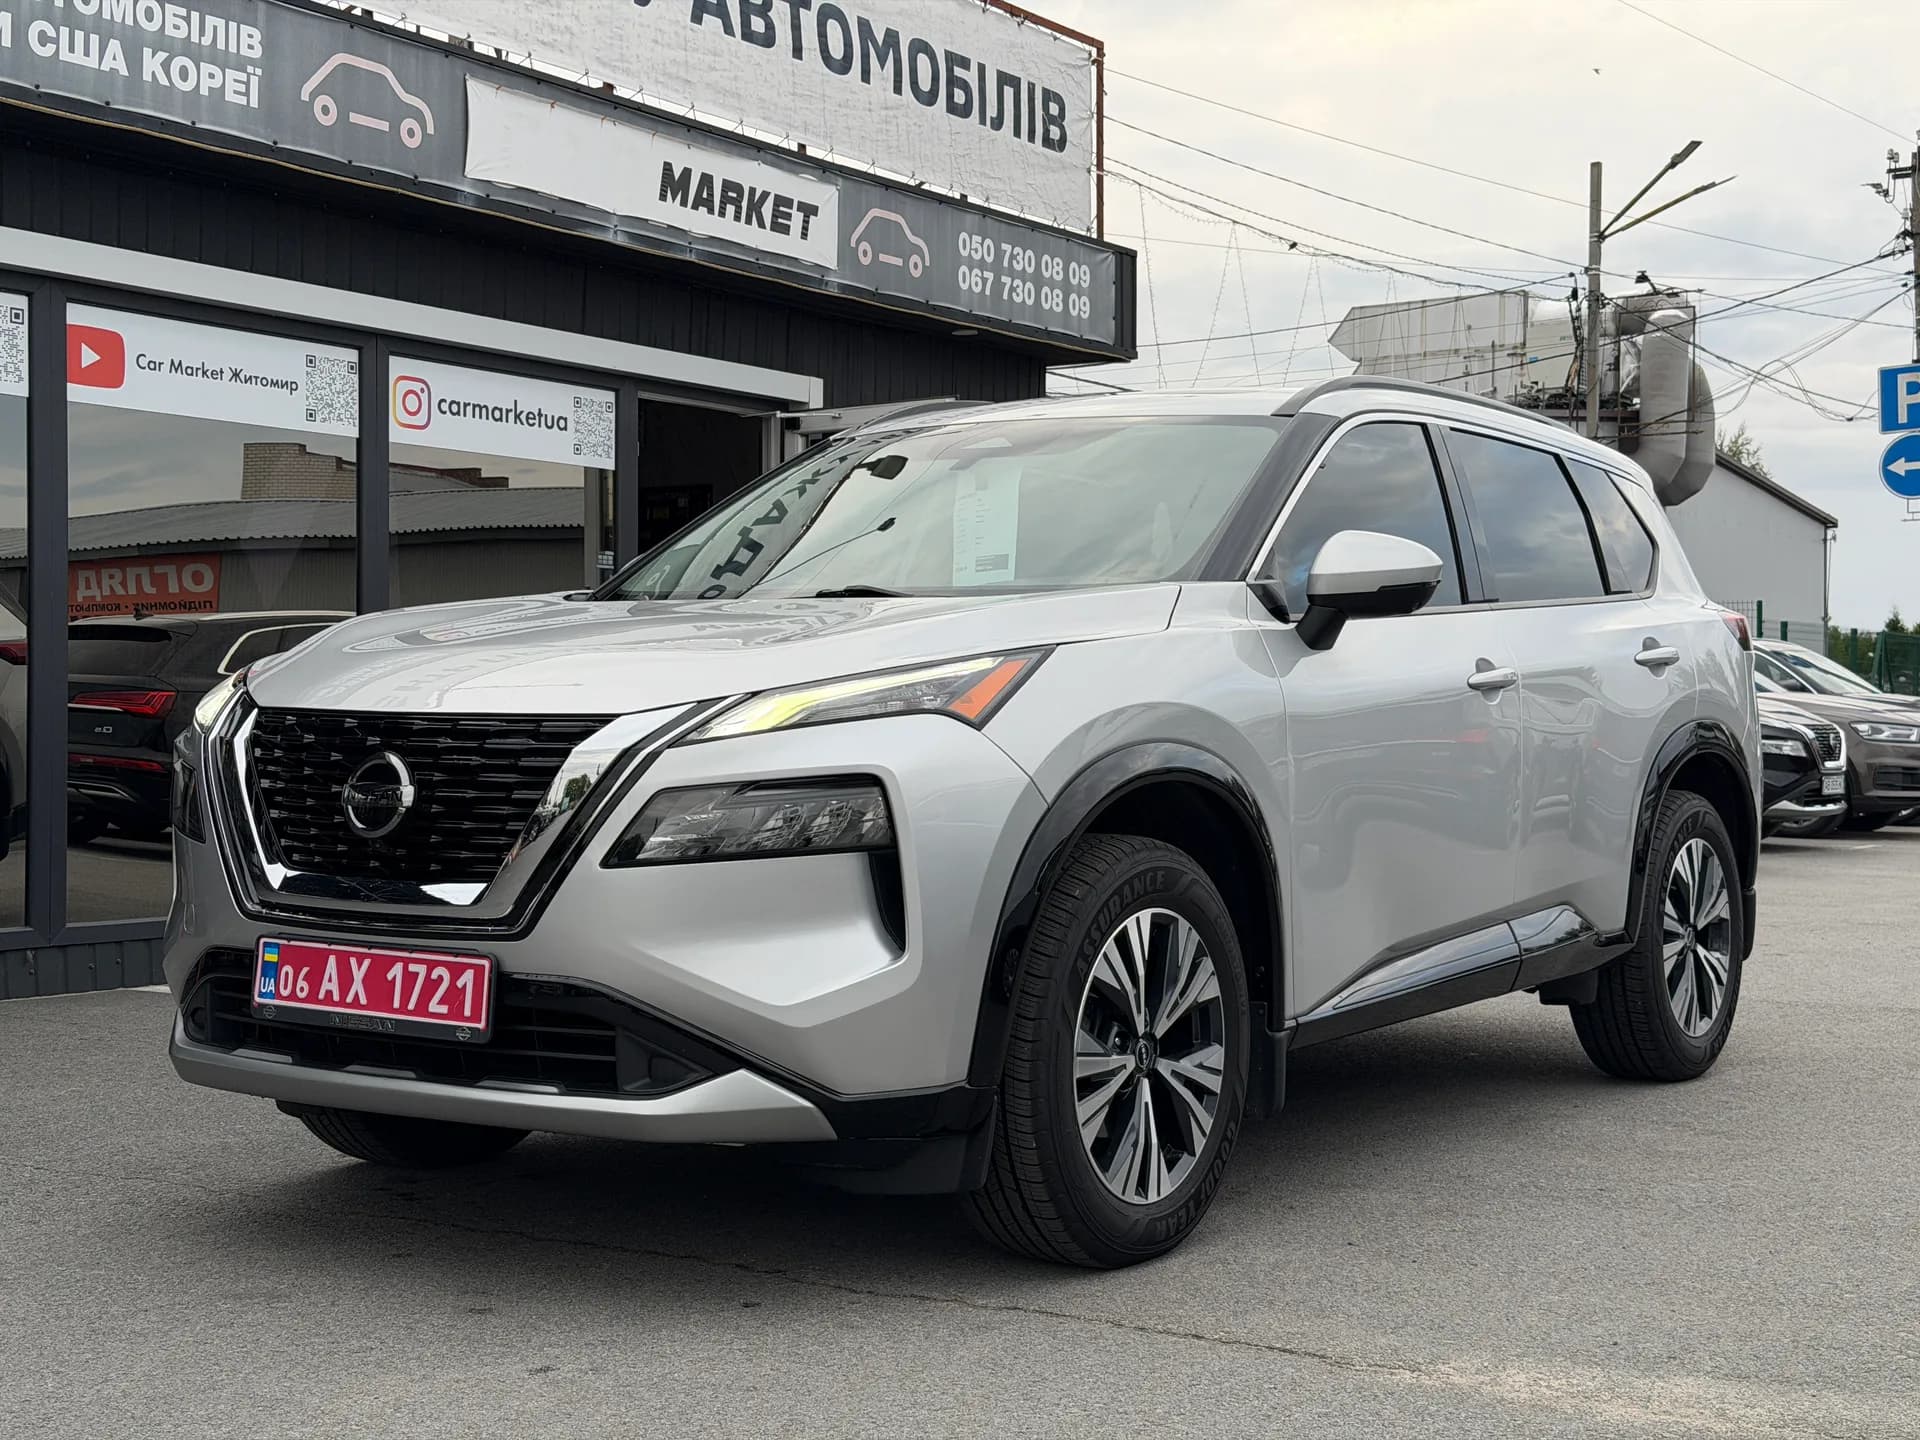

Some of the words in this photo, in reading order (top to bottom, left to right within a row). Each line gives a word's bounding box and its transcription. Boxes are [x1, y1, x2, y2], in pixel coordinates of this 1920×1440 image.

[36, 0, 263, 58] МОБІЛІВ
[28, 20, 129, 77] США
[142, 47, 263, 109] КОРЕЇ
[659, 160, 819, 241] MARKET
[958, 231, 995, 263] 050
[1001, 243, 1035, 274] 730
[1041, 254, 1064, 281] 08
[1068, 261, 1090, 288] 09
[958, 265, 994, 296] 067
[1000, 276, 1035, 306] 730
[1041, 286, 1063, 313] 08
[1068, 293, 1090, 319] 09
[136, 353, 164, 372] Car
[169, 358, 224, 381] Market
[228, 366, 299, 395] Житомир
[1897, 371, 1920, 424] P
[437, 398, 568, 431] carmarketua
[260, 977, 275, 994] UA
[279, 965, 310, 999] 06
[318, 955, 371, 1006] AX
[386, 962, 475, 1017] 1721
